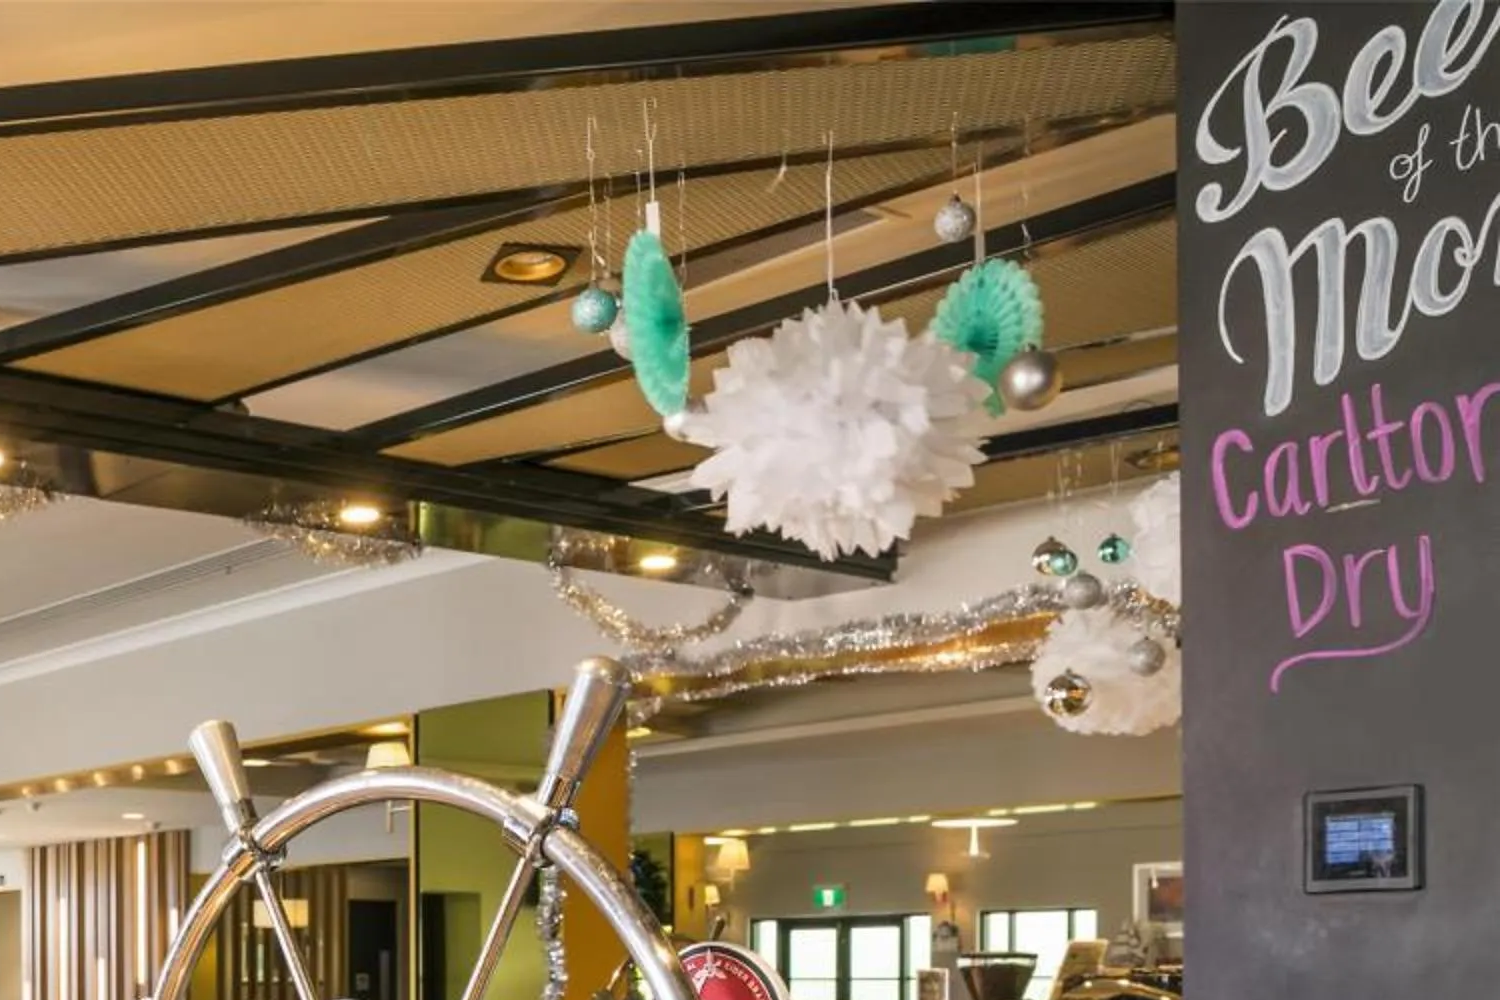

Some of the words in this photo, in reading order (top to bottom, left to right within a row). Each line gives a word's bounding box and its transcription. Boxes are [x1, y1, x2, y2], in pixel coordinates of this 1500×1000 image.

[1196, 0, 1500, 222] Bee
[1389, 122, 1433, 203] of
[1450, 104, 1500, 170] th
[1217, 191, 1500, 416] Mo
[1271, 535, 1436, 693] Dry
